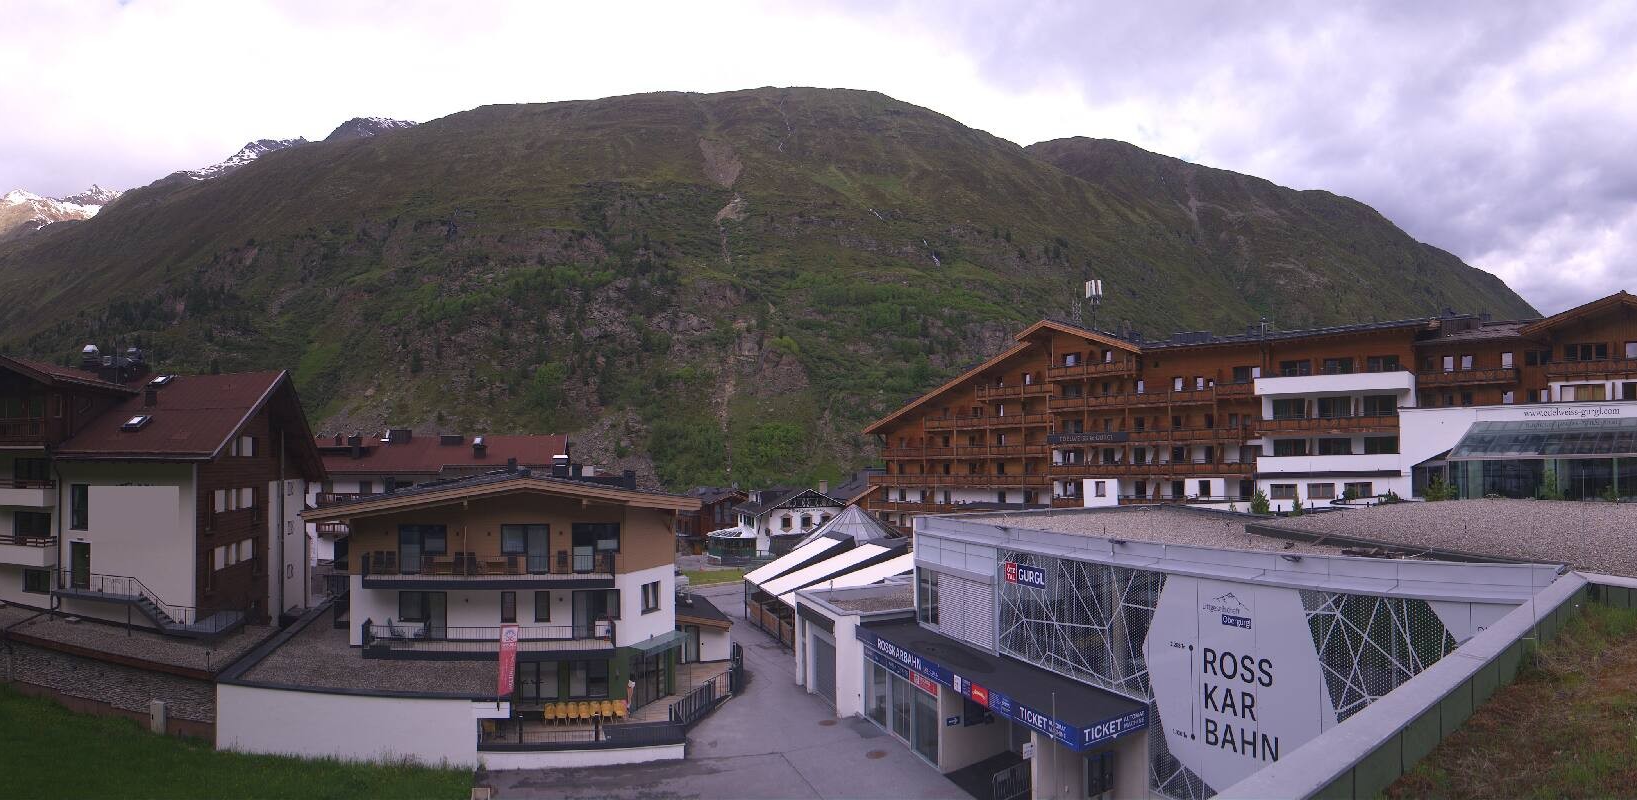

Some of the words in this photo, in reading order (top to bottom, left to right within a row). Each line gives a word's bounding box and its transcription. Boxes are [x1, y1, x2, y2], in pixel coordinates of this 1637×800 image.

[1523, 407, 1620, 417] www.edelweiss-gurgl.com
[1018, 568, 1045, 586] GURGL
[877, 638, 922, 670] ROSSKARBAHN
[1203, 647, 1273, 687] ROSS
[1204, 682, 1257, 722] KAR
[1019, 706, 1048, 730] TICKET
[1084, 717, 1124, 742] TICKET
[1205, 717, 1279, 763] BAHN
